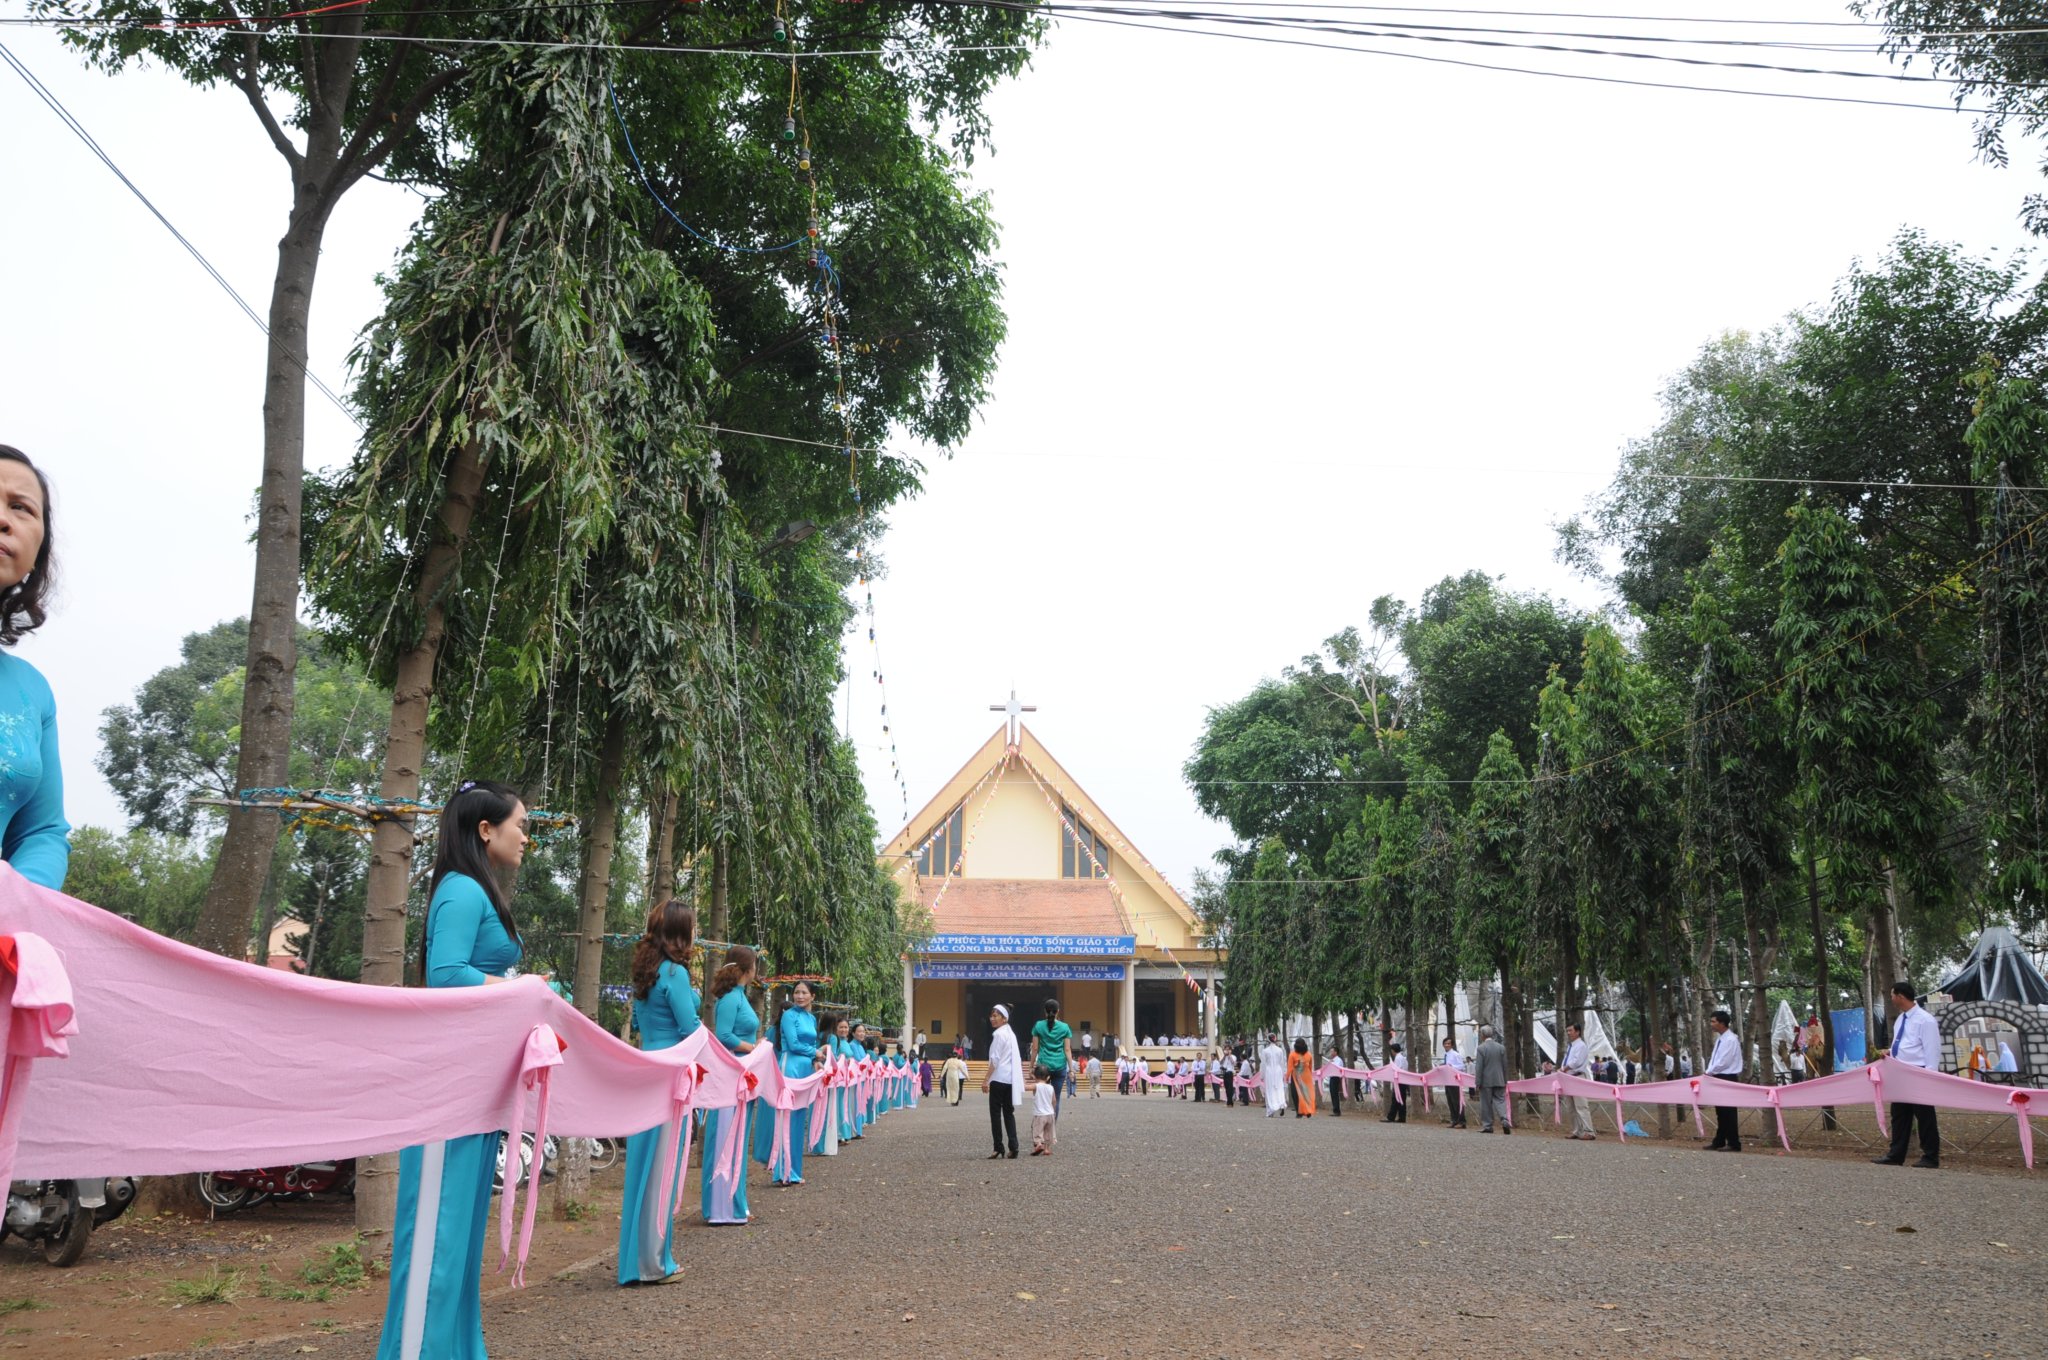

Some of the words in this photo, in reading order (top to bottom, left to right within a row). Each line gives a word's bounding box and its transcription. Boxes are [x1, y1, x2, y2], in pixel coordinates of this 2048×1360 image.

[948, 936, 976, 944] PHÚC
[979, 936, 996, 945] ÂM
[999, 936, 1021, 945] HÓA
[1046, 936, 1073, 945] SỐNG
[1077, 937, 1102, 946] GIÁO
[952, 945, 980, 953] CỘNG
[1016, 944, 1044, 953] SỐNG
